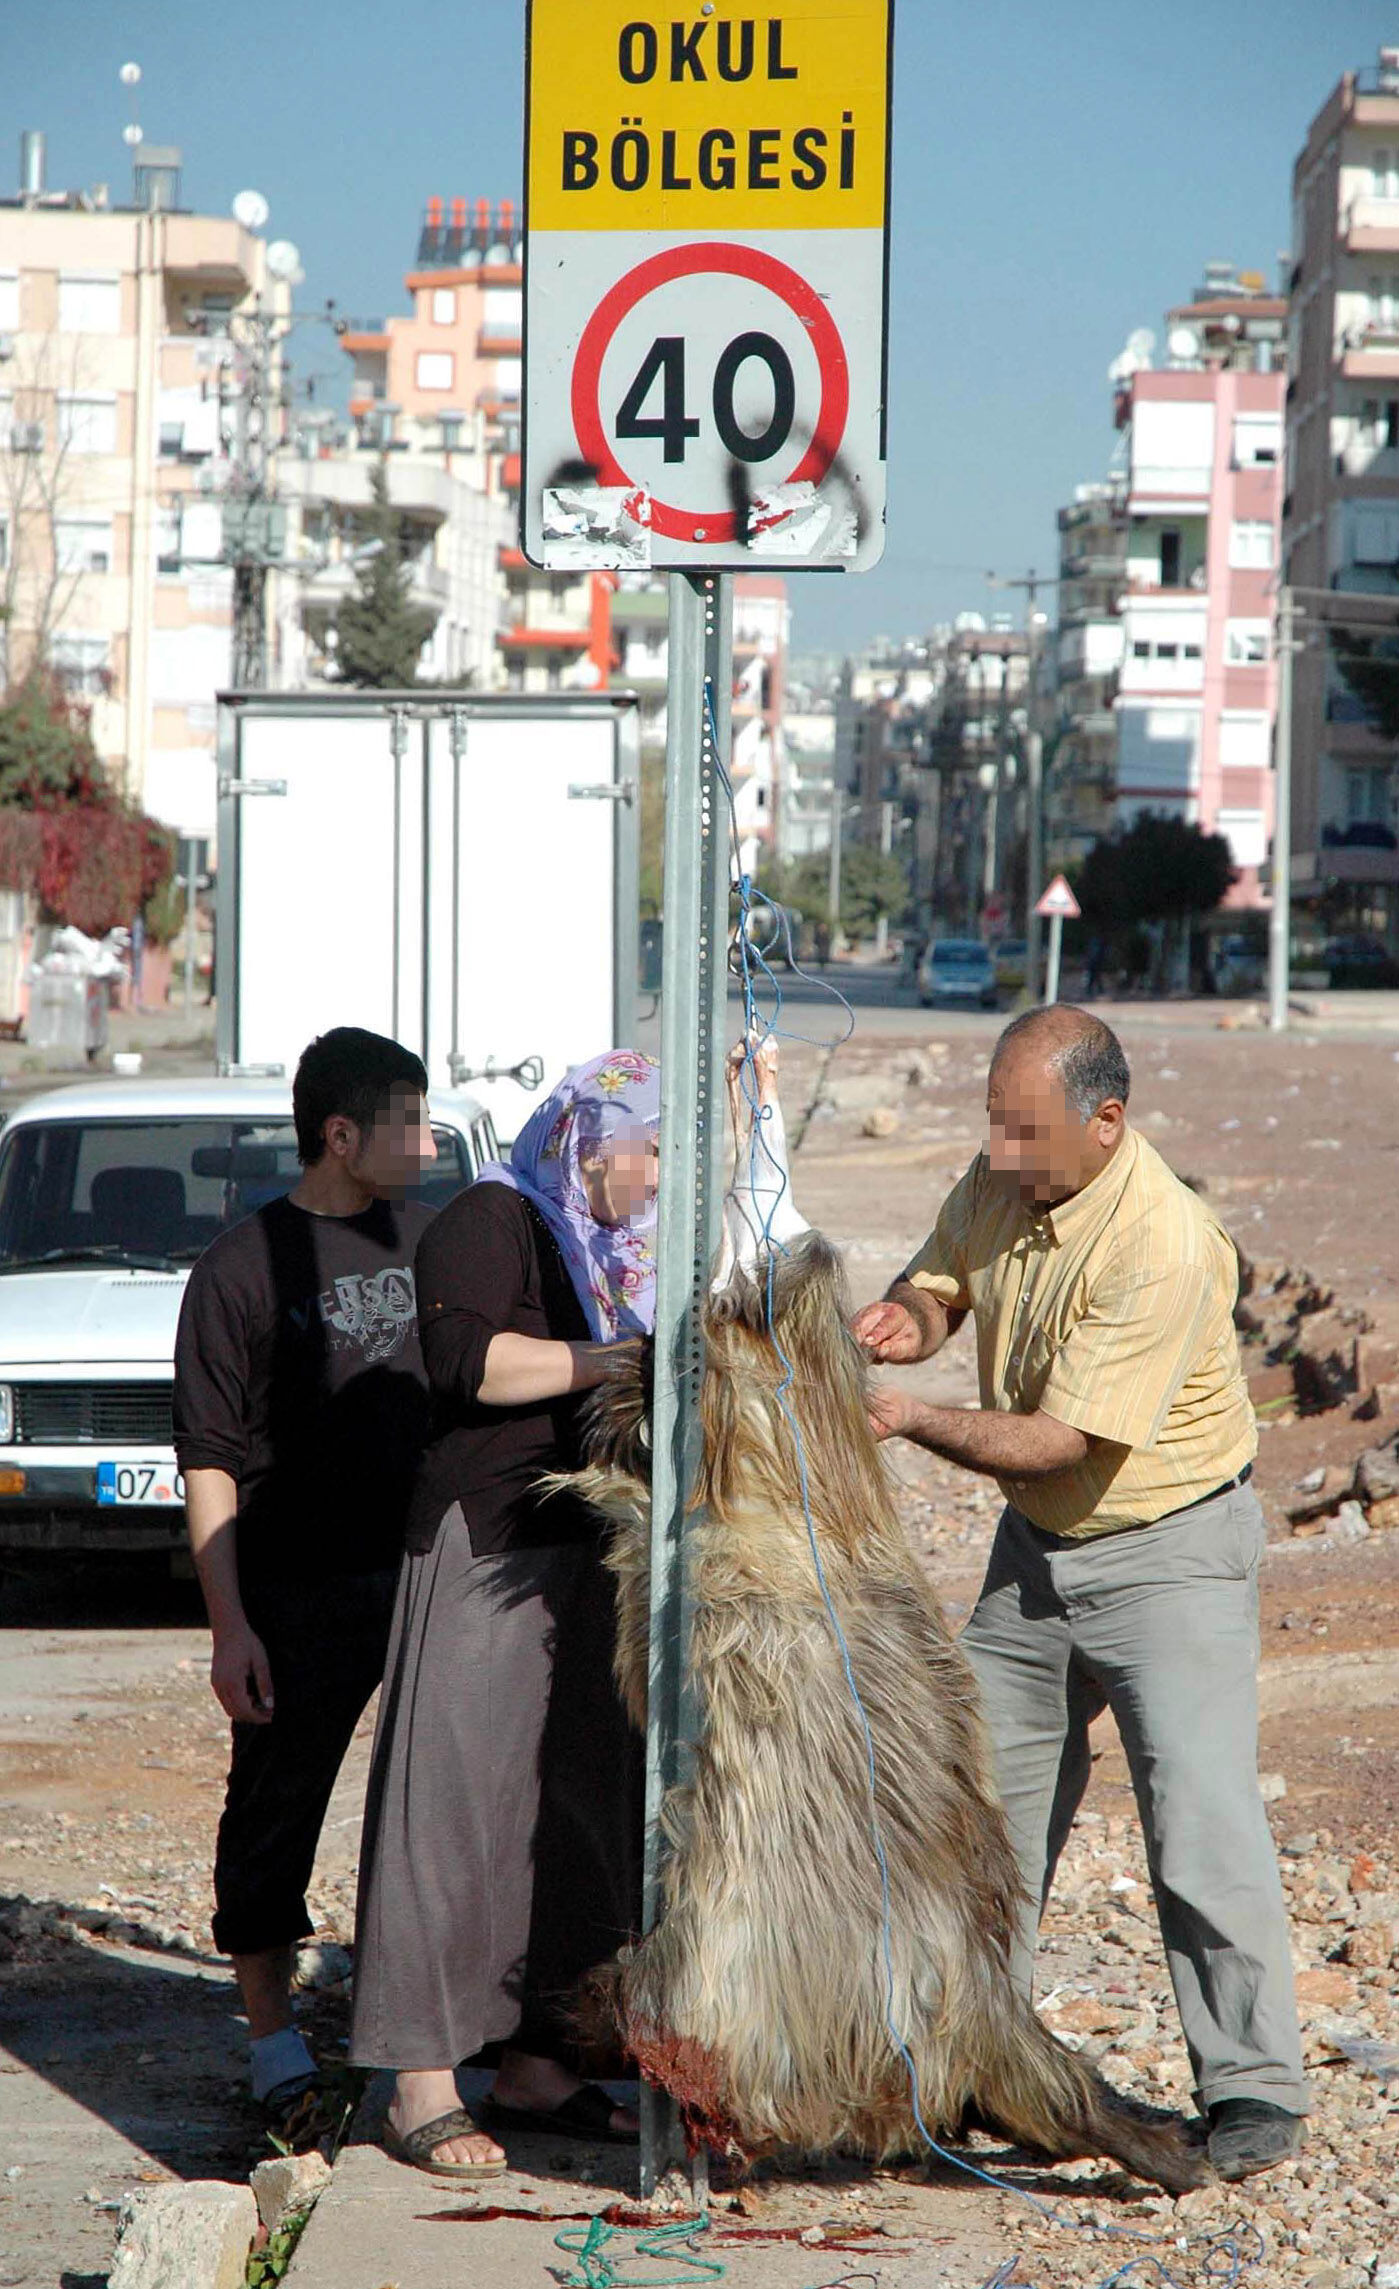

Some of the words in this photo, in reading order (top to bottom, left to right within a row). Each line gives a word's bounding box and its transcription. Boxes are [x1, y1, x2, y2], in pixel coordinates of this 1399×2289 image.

[618, 19, 799, 85] OKUL
[562, 111, 855, 191] BÖLGESİ
[615, 331, 796, 464] 40
[117, 1469, 156, 1500] 07
